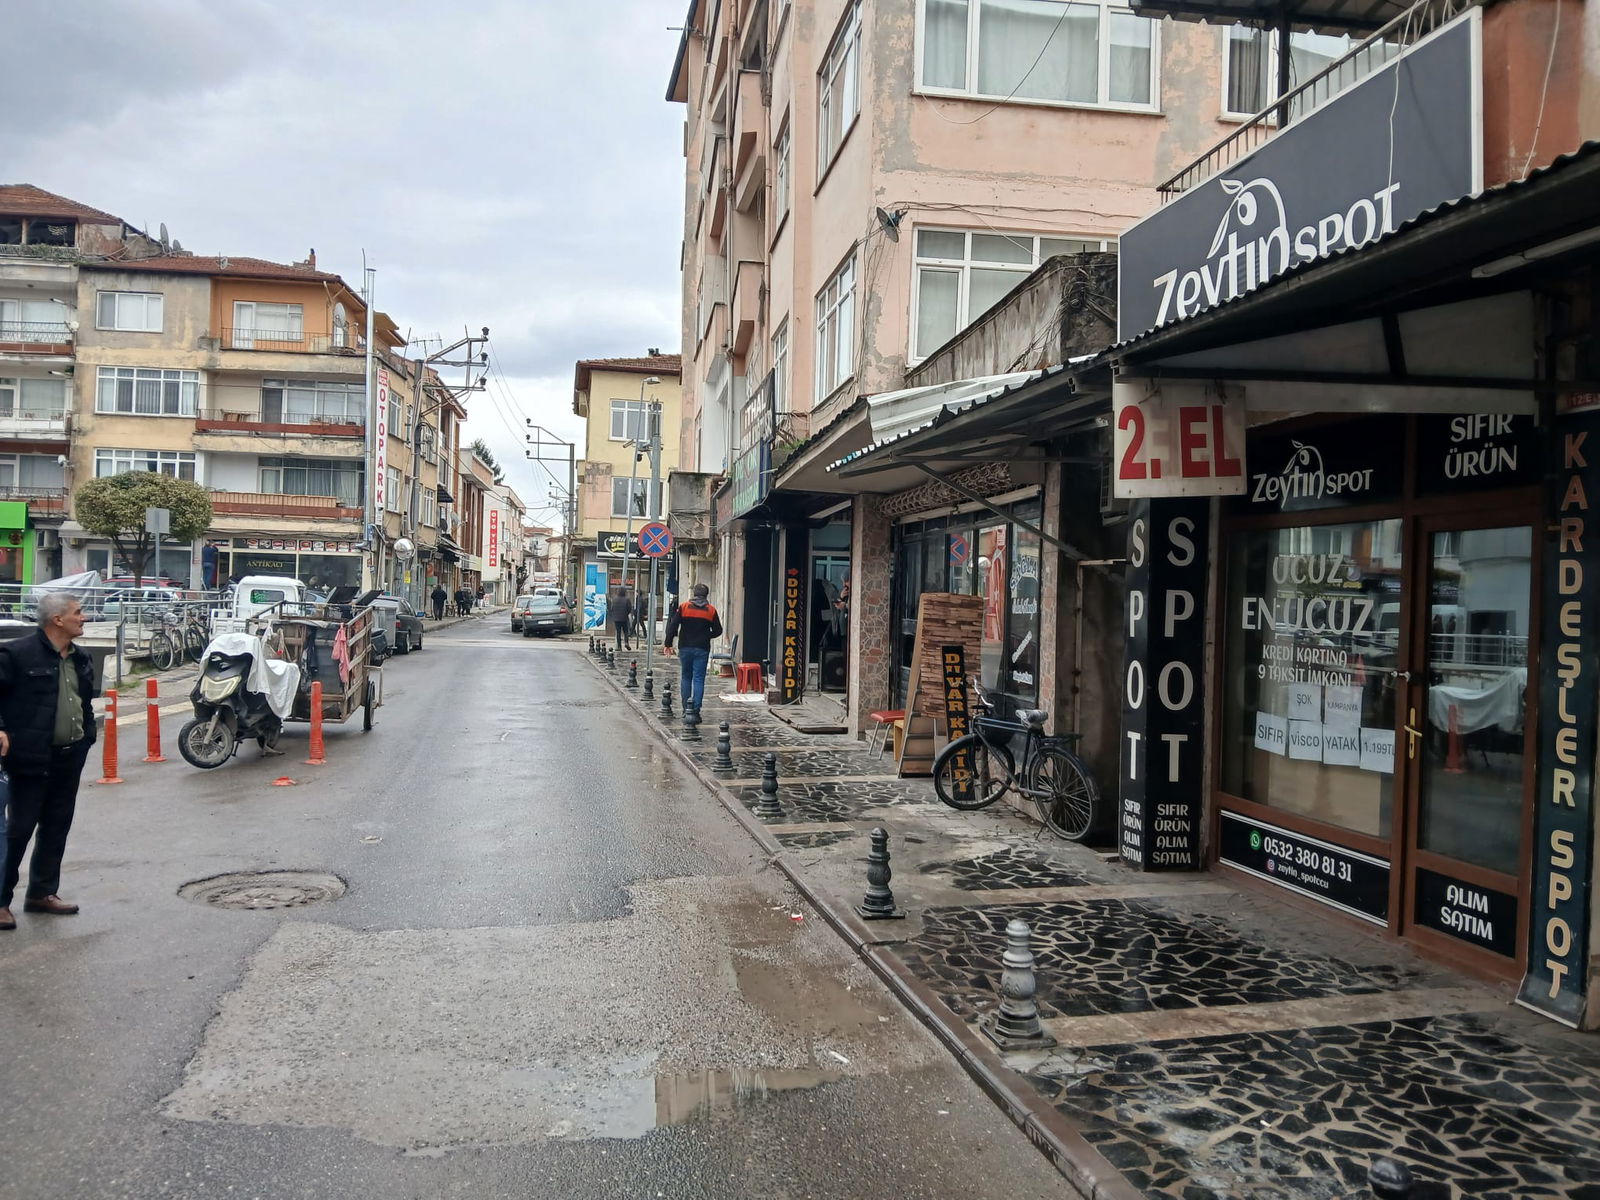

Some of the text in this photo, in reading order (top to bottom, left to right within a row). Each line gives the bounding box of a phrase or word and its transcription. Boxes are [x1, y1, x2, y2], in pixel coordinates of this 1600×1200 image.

[1295, 182, 1400, 263] SPOT
[1118, 404, 1242, 480] 2. EL
[1450, 413, 1513, 443] SIFIR
[376, 388, 386, 503] OTOPARK
[1444, 442, 1518, 479] ÜRÜN
[1252, 453, 1373, 511] Zeytin SPOT
[1272, 554, 1344, 584] UCUZ
[786, 578, 798, 630] DUVAR
[1241, 597, 1375, 636] EN UCUZ
[1553, 431, 1589, 808] KARDEŞLER
[1126, 519, 1145, 780] SPOT
[1157, 516, 1196, 782] SPOT
[1262, 643, 1348, 669] KREDİ KARTINA
[1258, 664, 1351, 687] 9 TAKSİT İMKANI
[1296, 693, 1359, 712] ŞOK KAMPANYA
[1257, 724, 1284, 744] SIFIR
[1324, 735, 1358, 751] YATAK
[1122, 811, 1142, 831] ÜRÜN
[1124, 798, 1141, 815] SIFIR
[1157, 803, 1189, 816] SIFIR
[1124, 830, 1141, 847] ALIM
[1154, 816, 1191, 832] ÜRÜN
[1121, 844, 1142, 863] SATIM
[1156, 836, 1188, 849] ALIM
[1152, 851, 1191, 865] SATIM
[1263, 836, 1352, 882] 0532 380 81 31
[1446, 884, 1489, 914] ALIM
[1545, 829, 1576, 998] SPOT
[1440, 906, 1493, 941] SATIM
